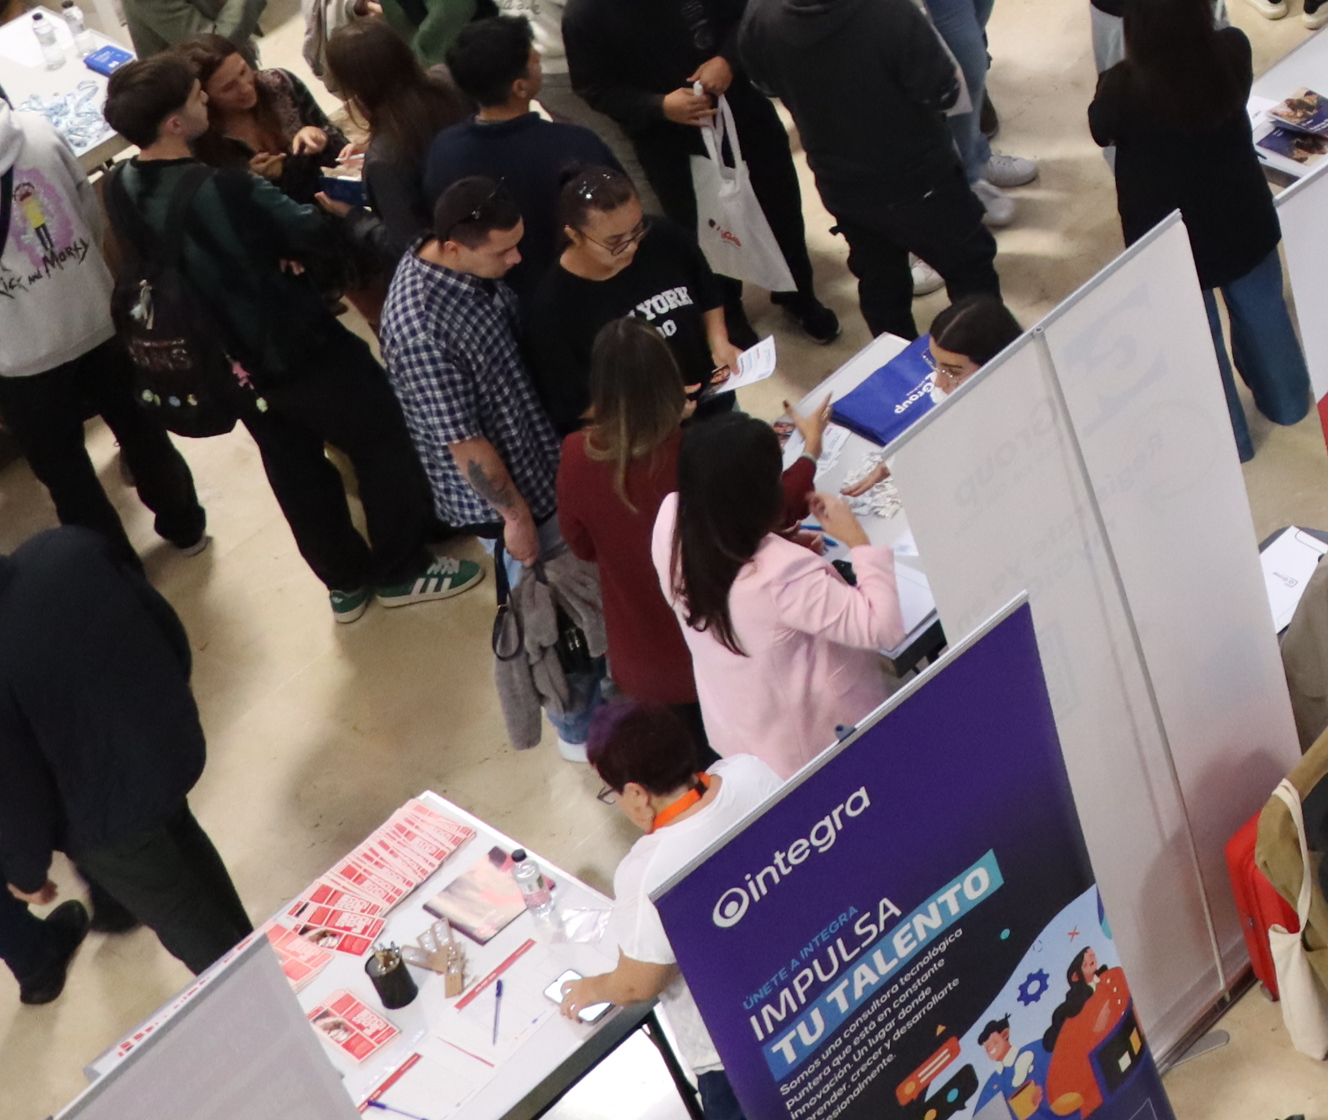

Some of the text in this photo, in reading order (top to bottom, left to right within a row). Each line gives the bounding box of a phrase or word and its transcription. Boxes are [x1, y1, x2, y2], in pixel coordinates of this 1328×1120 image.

[636, 286, 693, 321] YORK
[894, 381, 935, 414] Group
[745, 786, 871, 902] integra
[742, 906, 858, 1011] ÚNETE A INTEGRA
[750, 897, 902, 1041] IMPULSA
[771, 866, 990, 1065] TU TALENTO
[780, 928, 963, 1096] Somos una consultora tecnológica
[786, 957, 945, 1110] puntera que está en constante
[790, 986, 932, 1120] innovación. Un lugar donde
[850, 1053, 884, 1082] crecer
[884, 1039, 892, 1051] y
[892, 978, 960, 1041] desarrollarte
